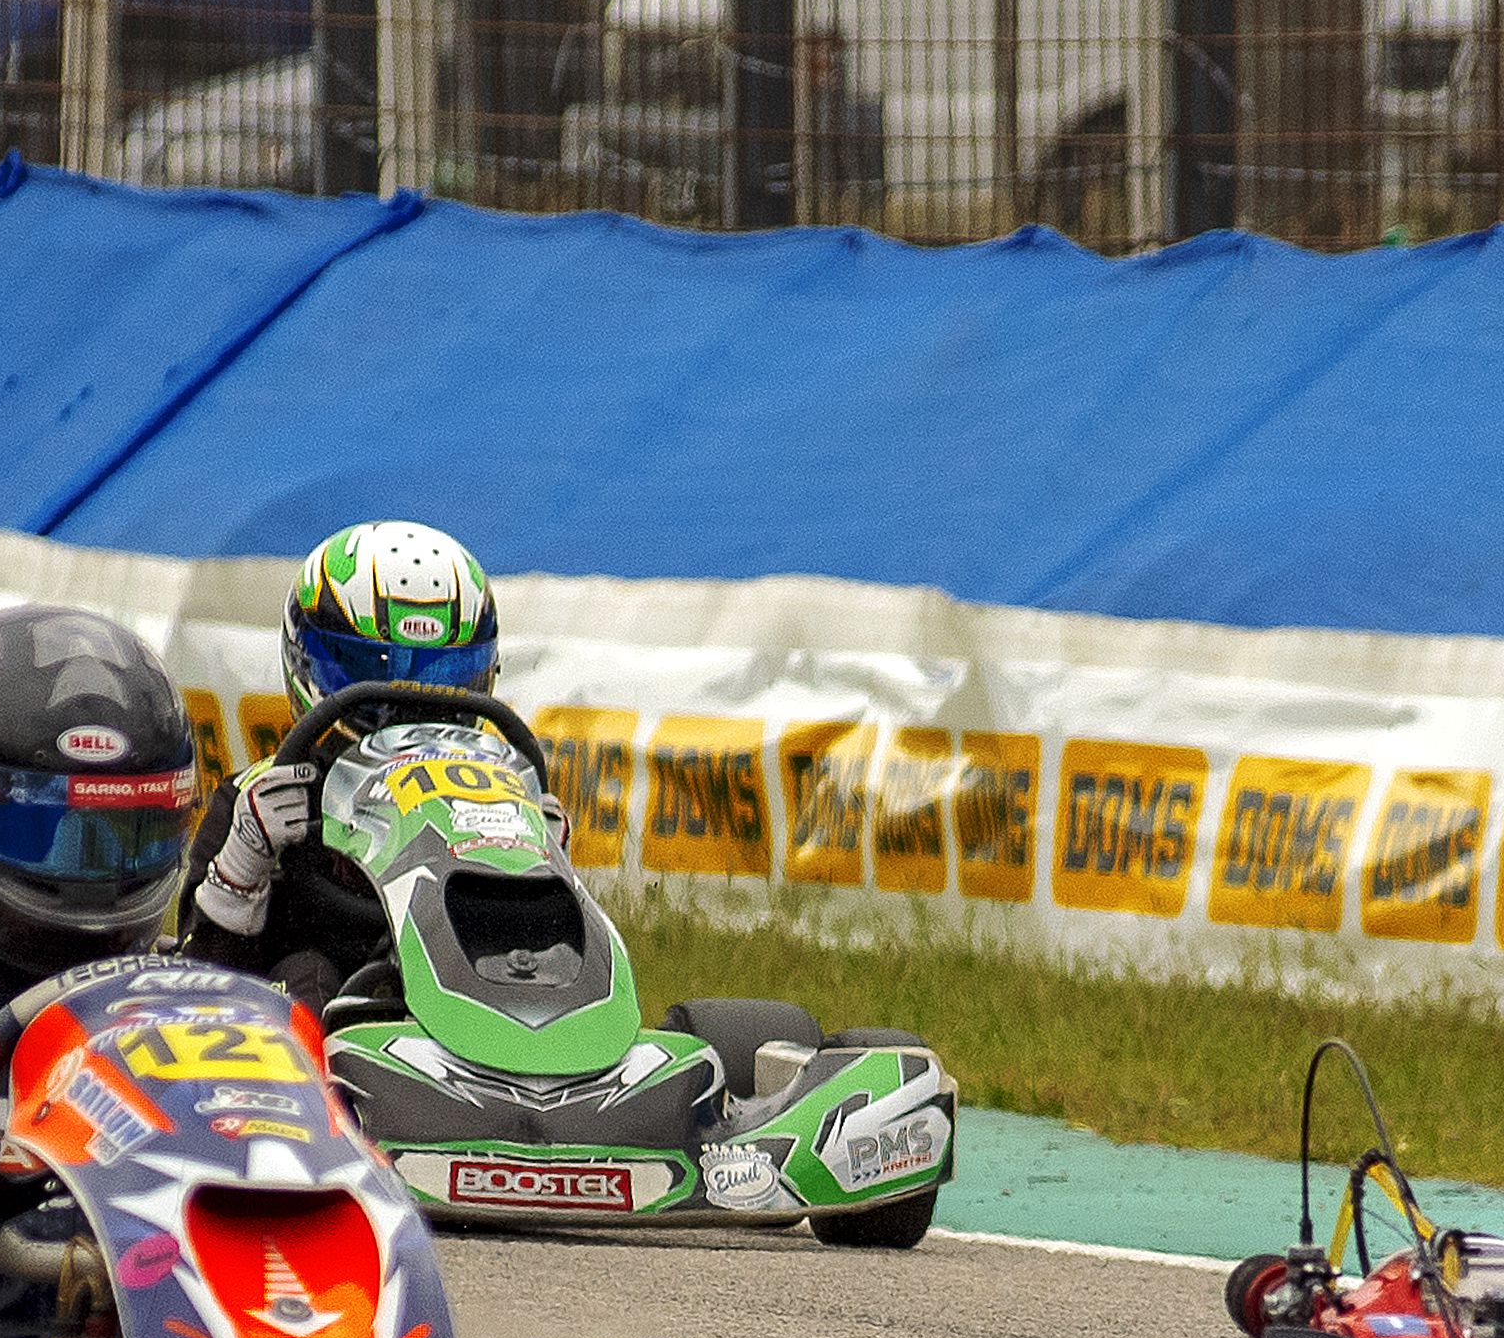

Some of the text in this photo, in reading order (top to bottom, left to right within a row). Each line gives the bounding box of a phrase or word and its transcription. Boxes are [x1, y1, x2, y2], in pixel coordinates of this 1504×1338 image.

[403, 620, 439, 635] BELL
[68, 734, 116, 752] BELL
[139, 781, 170, 794] ITALY
[648, 744, 763, 844] DOMS
[1064, 772, 1195, 881] DOMS
[1222, 788, 1355, 896] DOMS
[1372, 800, 1482, 907] DOMS
[121, 1024, 312, 1075] 121
[846, 1117, 933, 1171] PMS
[457, 1167, 626, 1201] BOOSTEK
